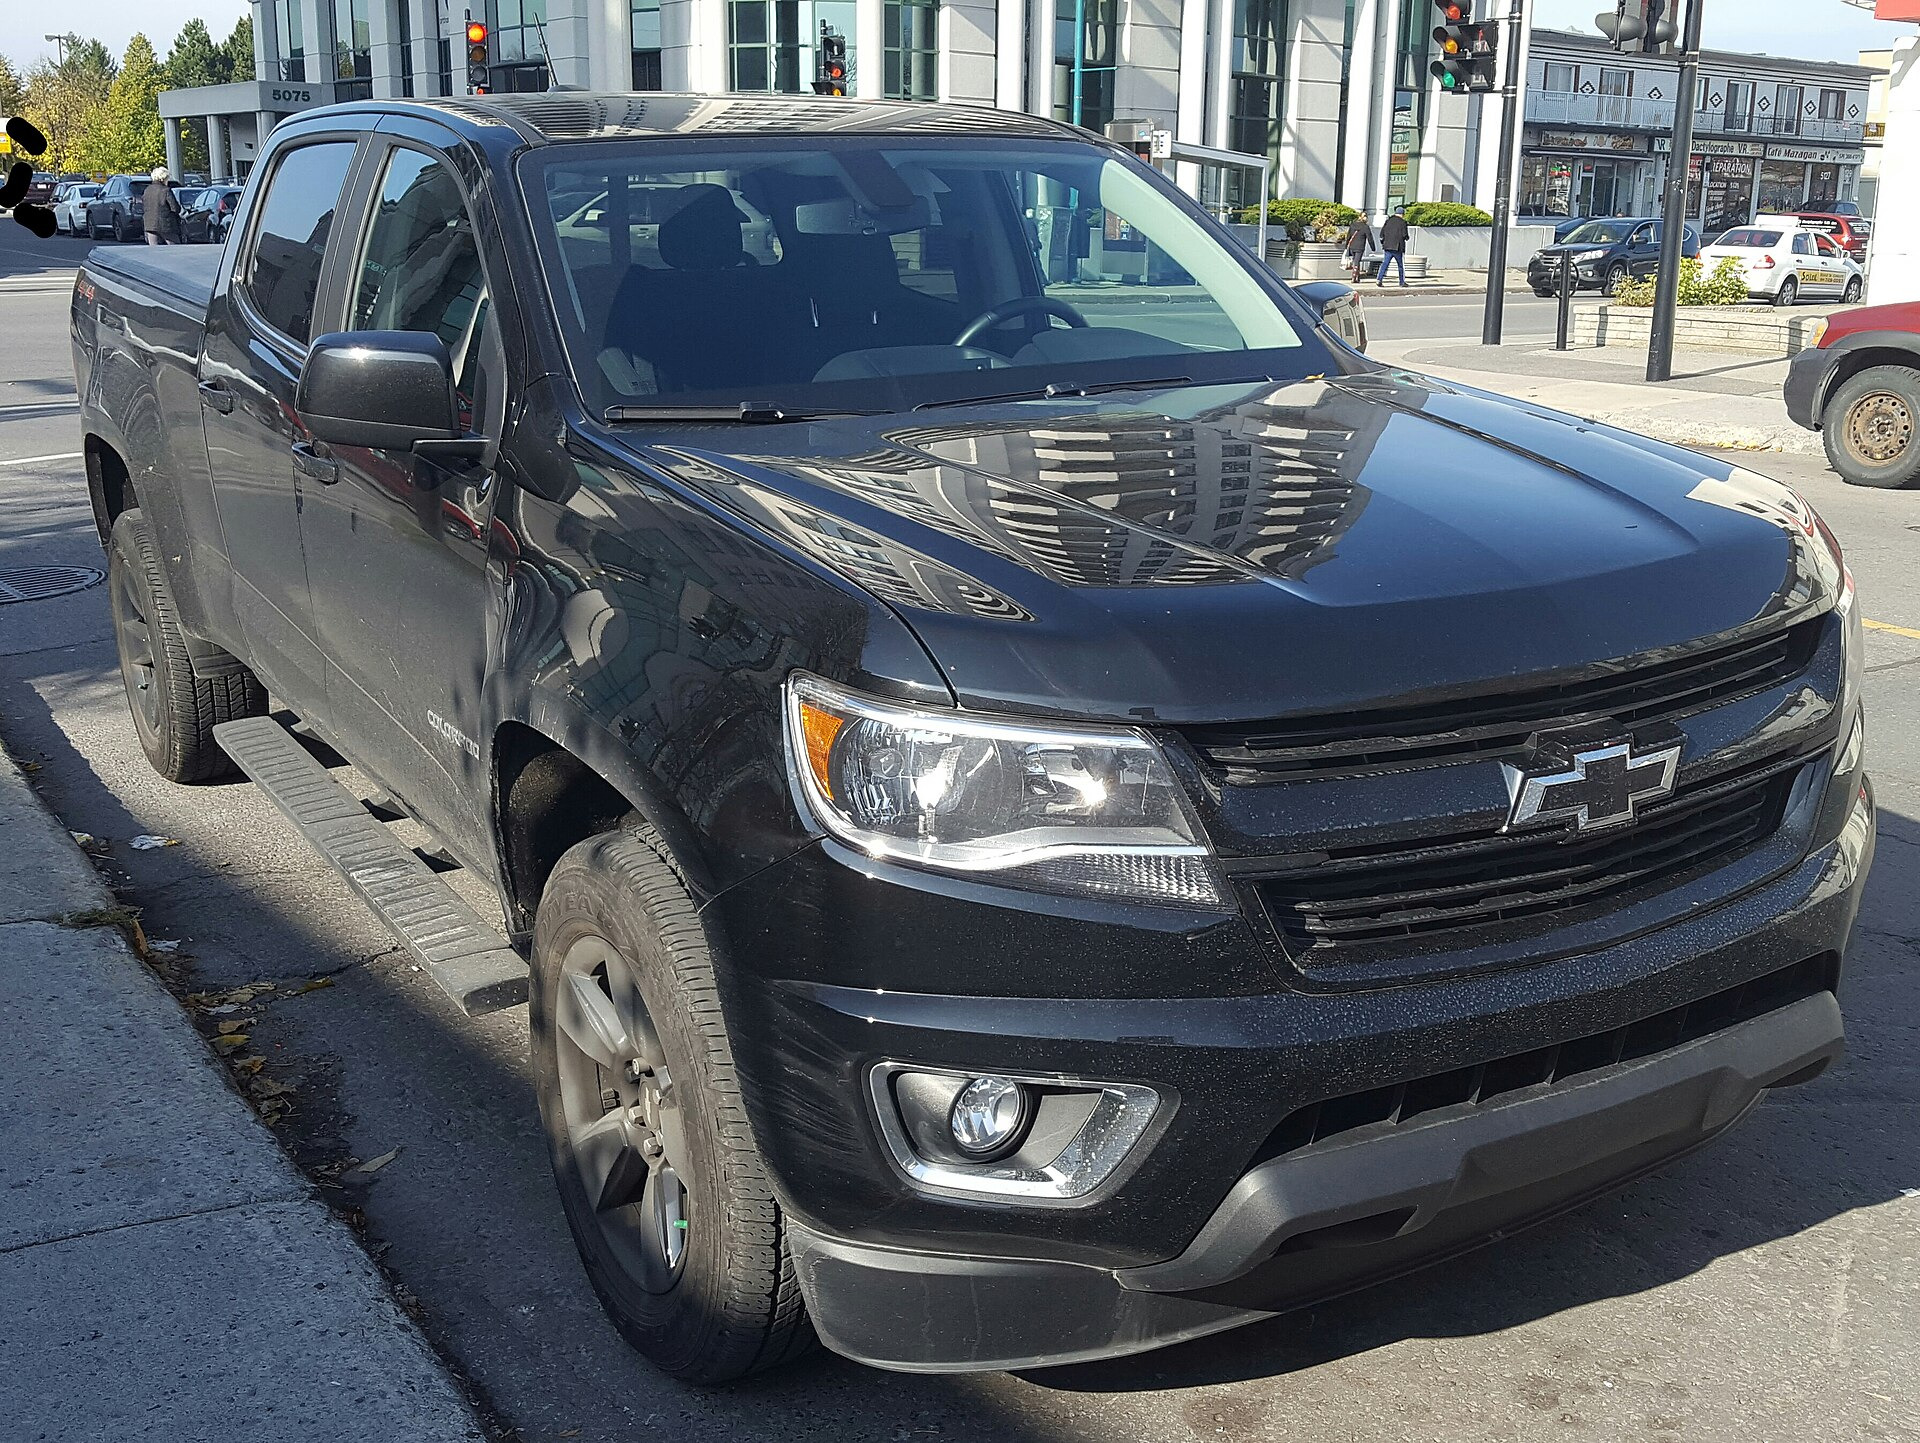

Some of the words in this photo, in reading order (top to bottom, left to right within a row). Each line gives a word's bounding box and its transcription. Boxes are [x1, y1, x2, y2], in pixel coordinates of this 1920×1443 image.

[272, 89, 311, 102] 5075
[1692, 141, 1734, 154] Dactylographe
[1767, 147, 1782, 157] Café
[1784, 149, 1817, 161] Mazagan
[426, 709, 480, 761] COLORADO
